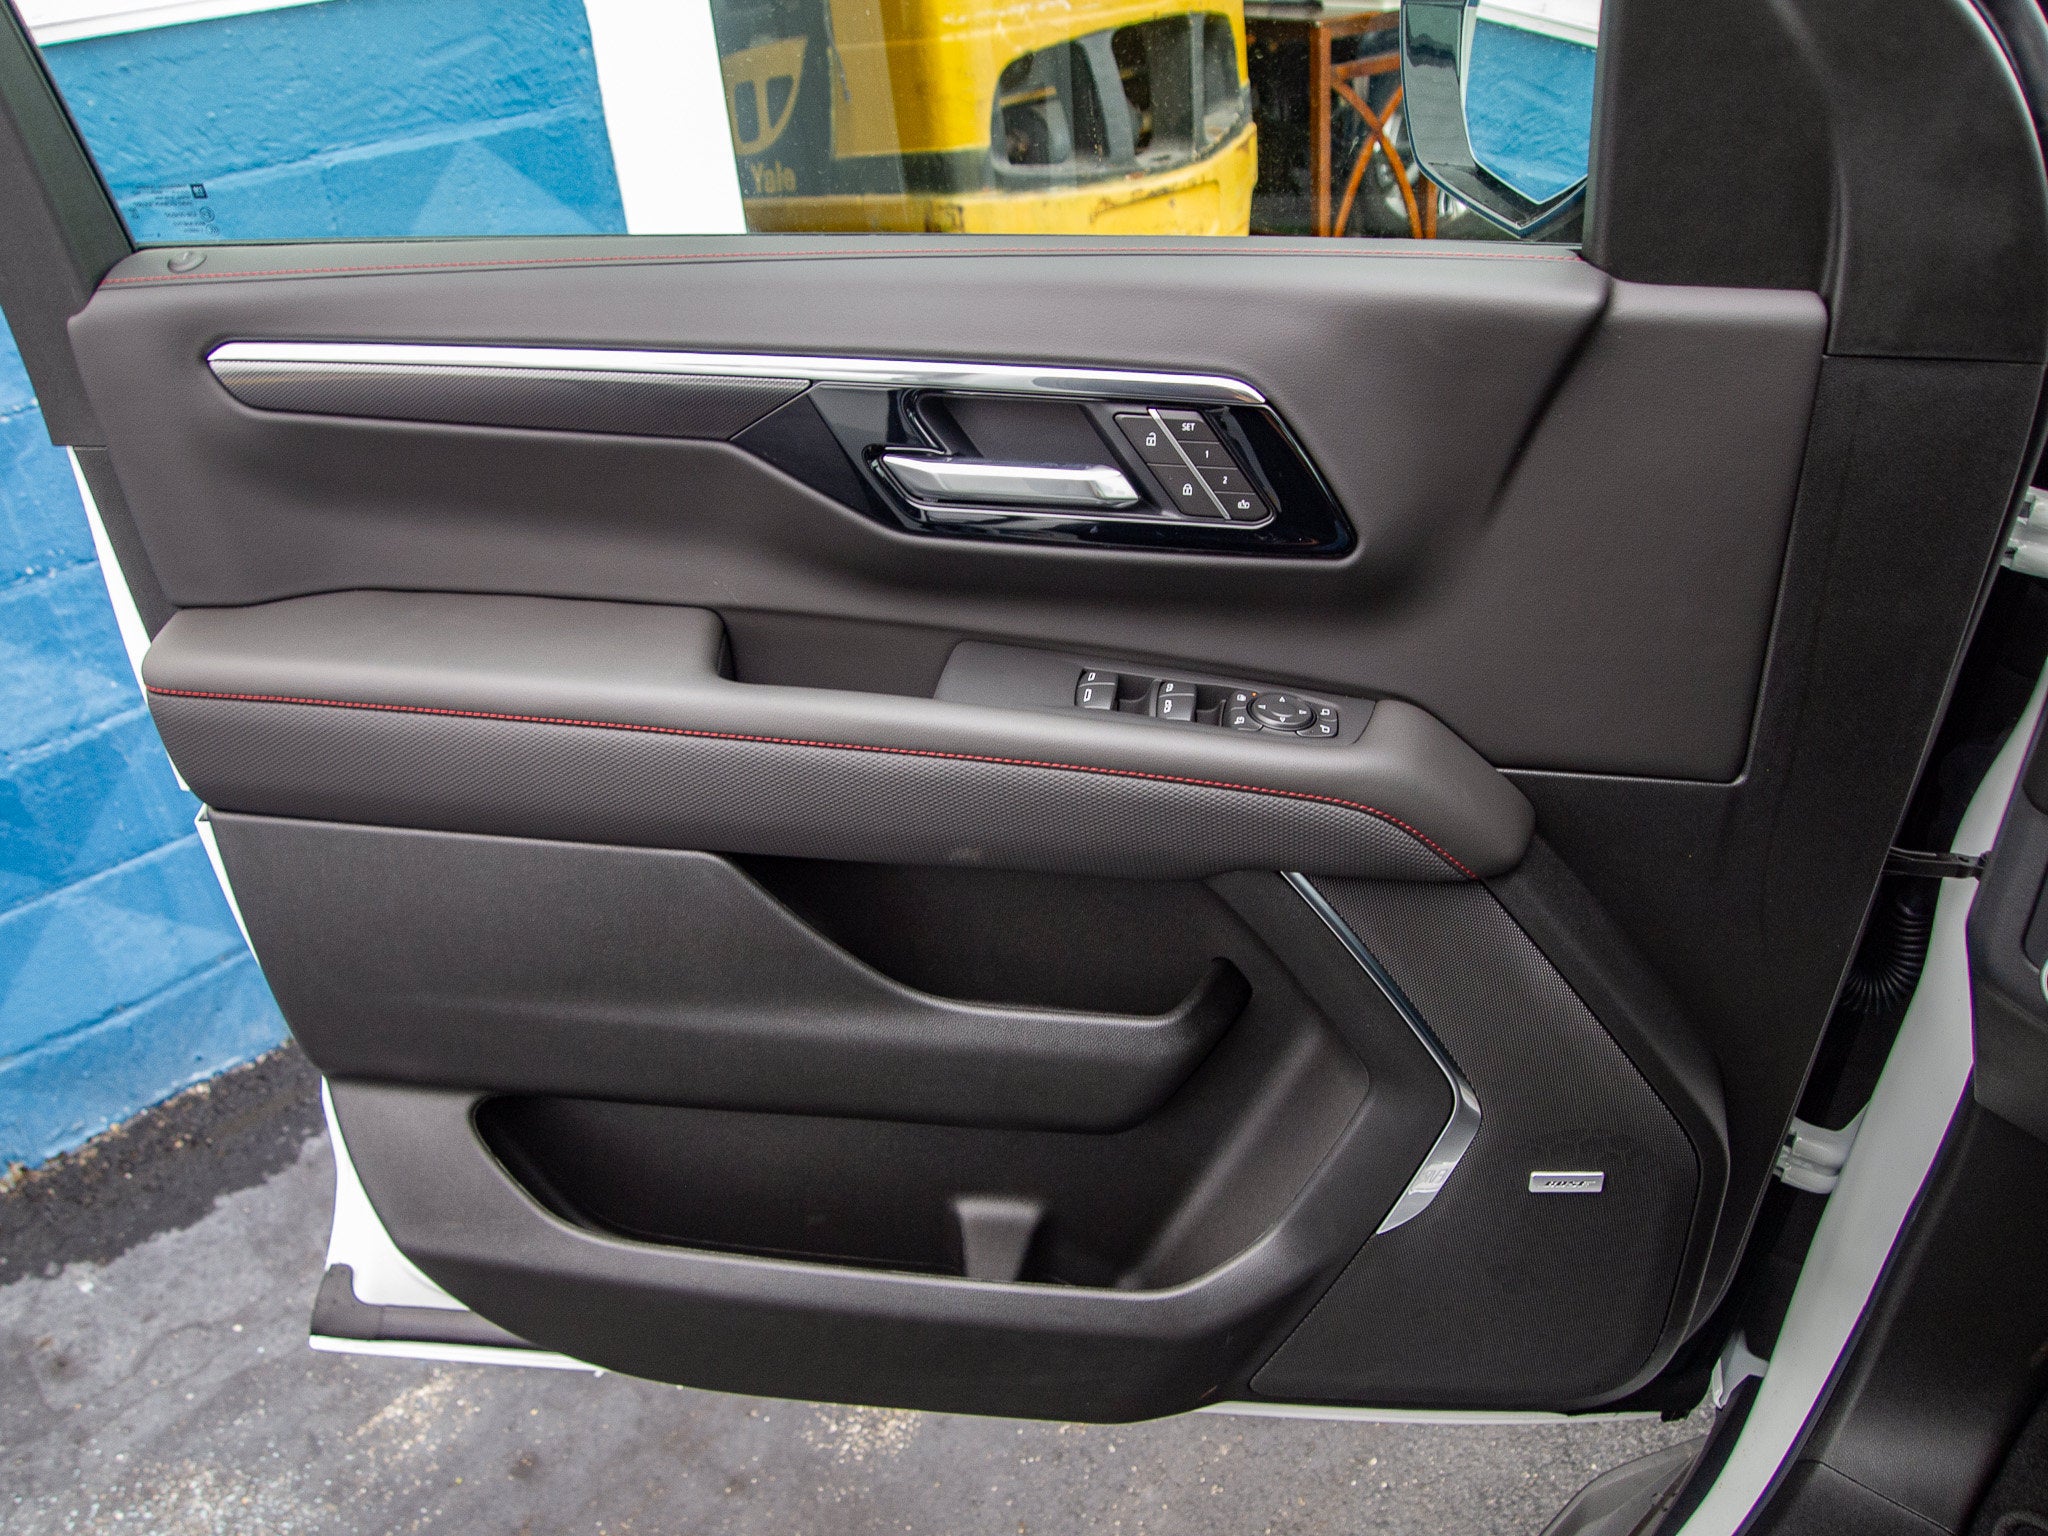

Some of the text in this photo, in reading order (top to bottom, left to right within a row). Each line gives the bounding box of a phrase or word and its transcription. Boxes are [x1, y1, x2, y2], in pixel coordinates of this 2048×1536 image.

[750, 161, 797, 193] Yale
[1181, 422, 1196, 432] SET
[1205, 450, 1209, 459] 1
[1222, 475, 1228, 485] 2
